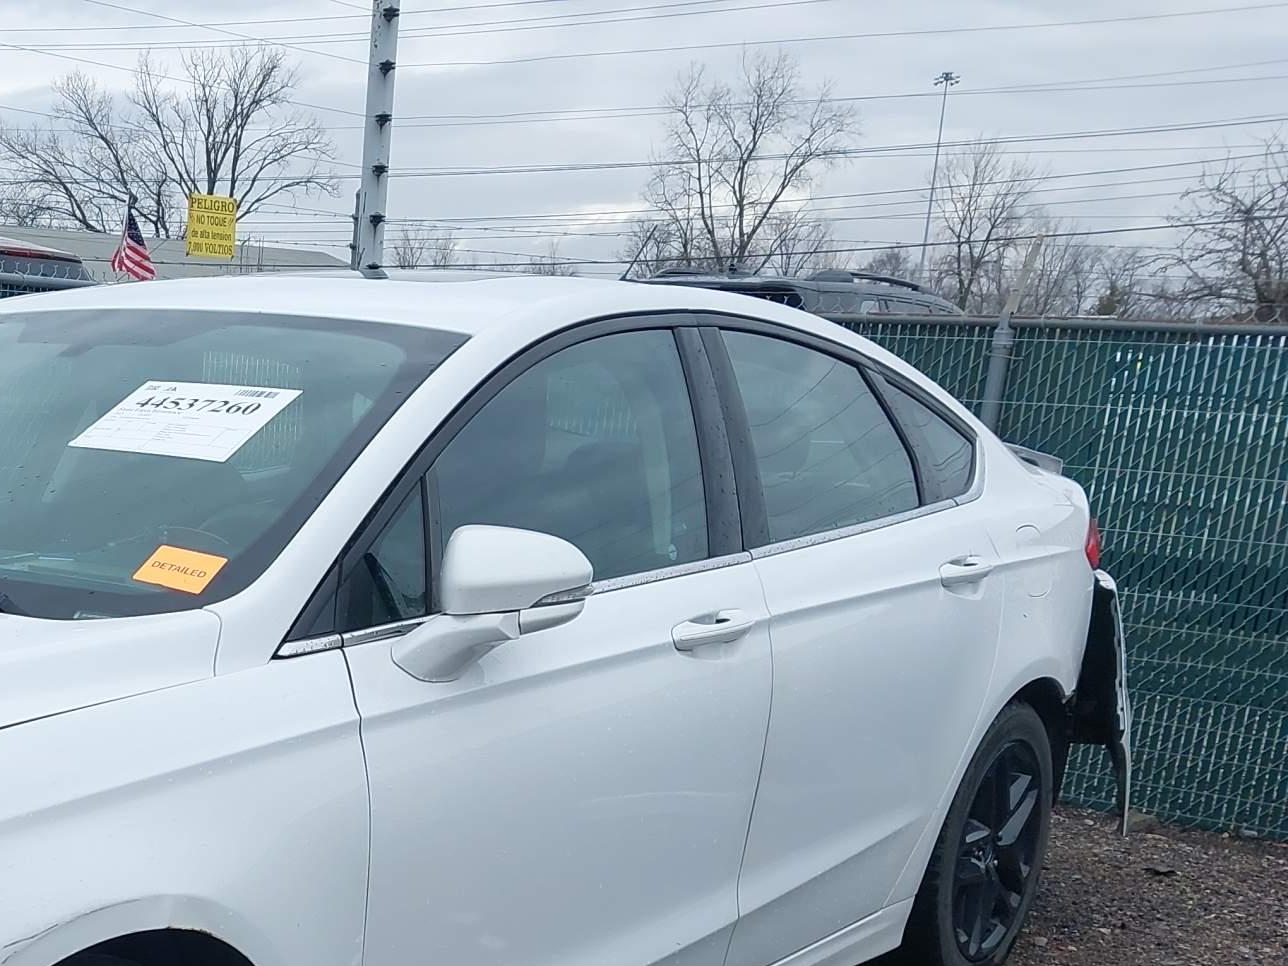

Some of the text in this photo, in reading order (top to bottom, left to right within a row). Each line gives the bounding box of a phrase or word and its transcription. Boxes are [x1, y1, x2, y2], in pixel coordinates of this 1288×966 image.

[190, 197, 235, 213] PELIGRO
[196, 214, 227, 227] NO TOQUE
[204, 242, 233, 256] VOLTIOS
[136, 396, 261, 416] 44537260
[151, 561, 207, 578] DETAILED
